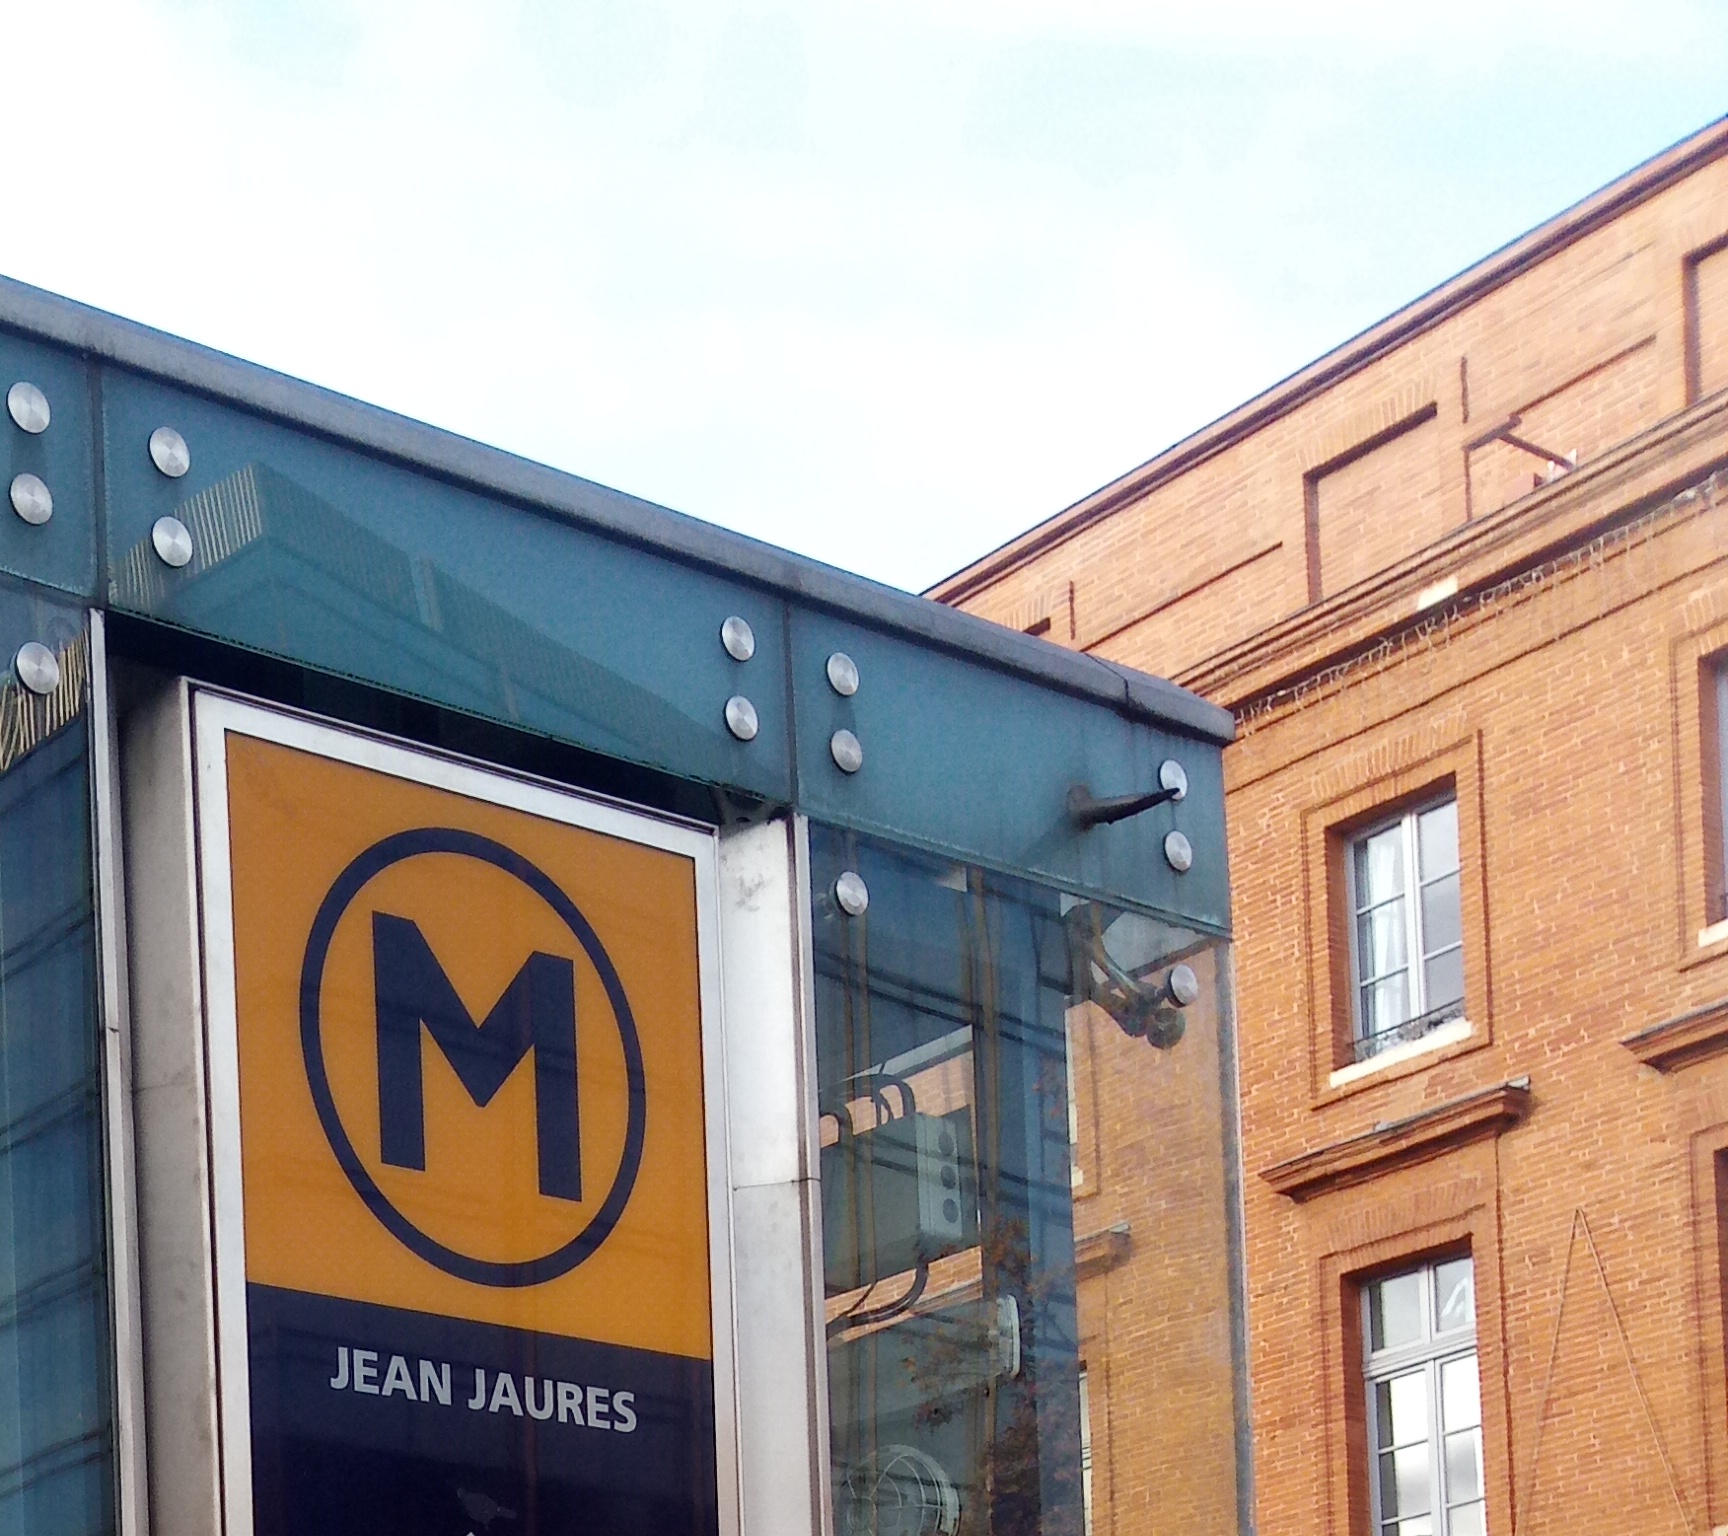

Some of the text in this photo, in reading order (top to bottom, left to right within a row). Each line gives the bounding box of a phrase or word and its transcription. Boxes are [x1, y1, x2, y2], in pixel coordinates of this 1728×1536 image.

[371, 910, 582, 1202] M
[330, 1347, 638, 1433] JEAN JAURES
